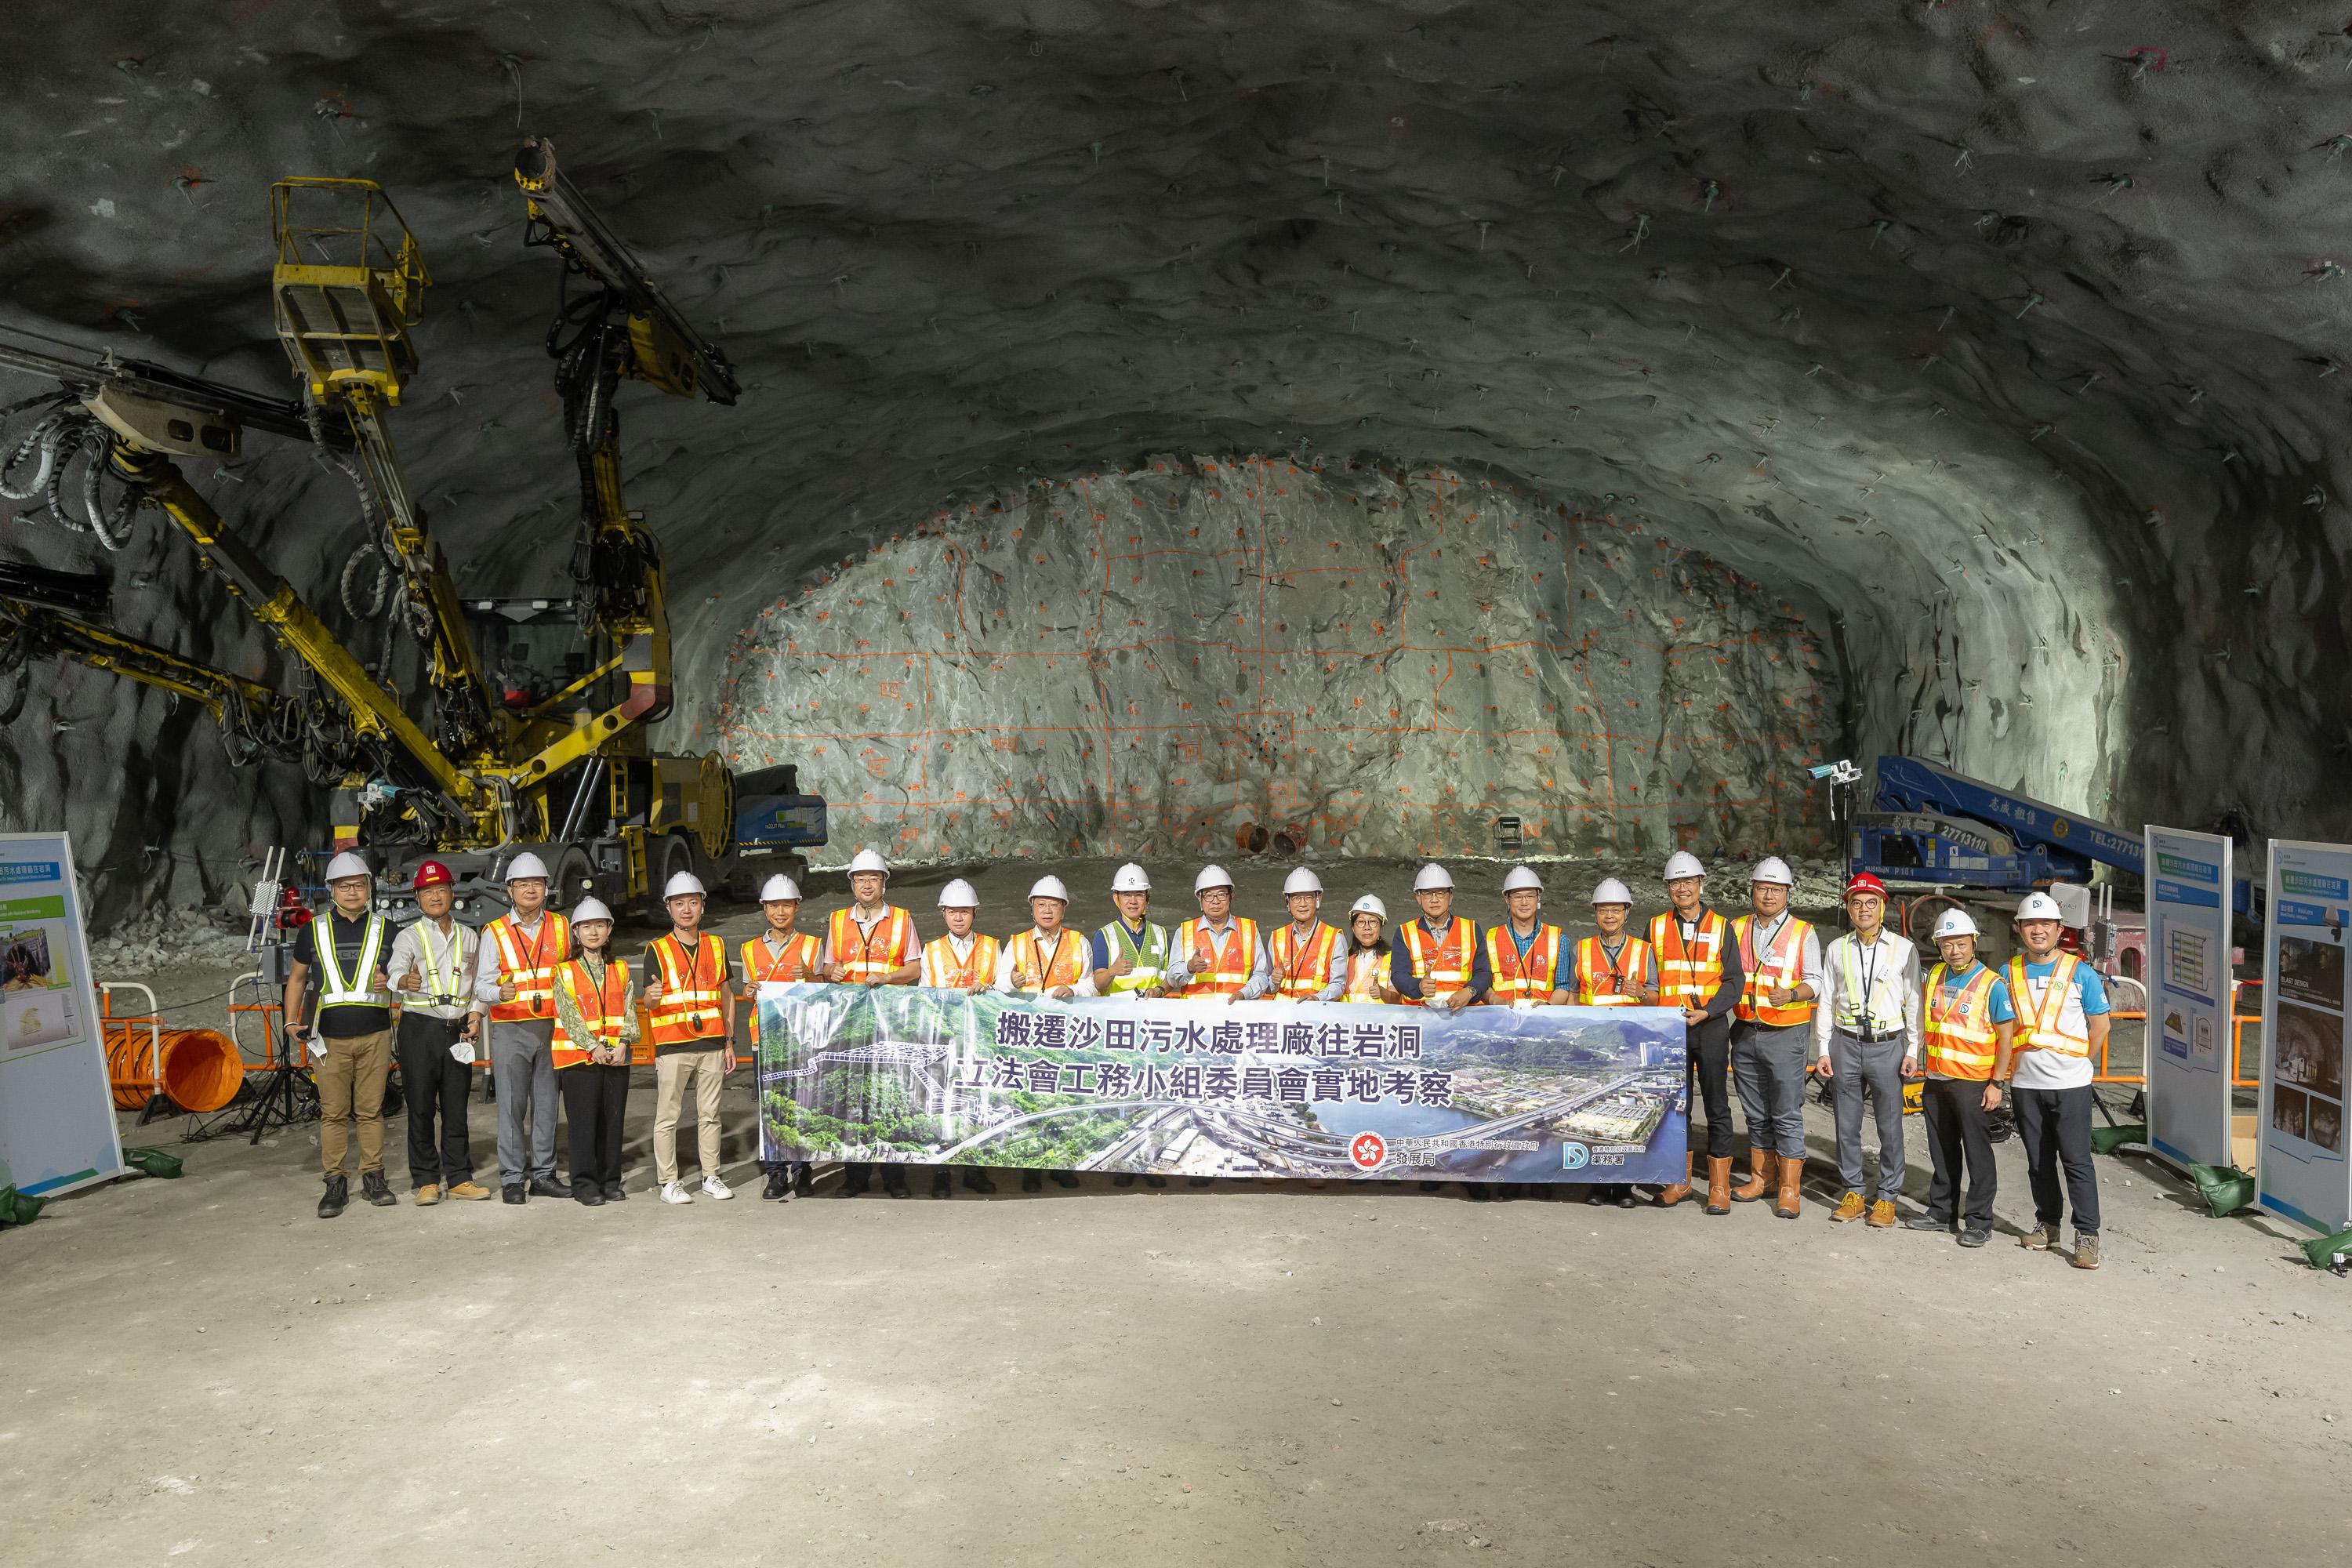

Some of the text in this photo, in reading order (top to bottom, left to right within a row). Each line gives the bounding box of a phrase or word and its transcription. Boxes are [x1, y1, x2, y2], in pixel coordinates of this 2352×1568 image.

[1941, 826, 1987, 852] 27713110
[996, 1011, 1422, 1059] 搬遷沙田污水處理廠往岩洞
[954, 1054, 1453, 1107] 立法會工務小組委員會實地考察
[1396, 1138, 1540, 1151] 中華人民共和國香港特別行政區政府
[1396, 1152, 1436, 1166] 發展局
[1592, 1154, 1624, 1166] 渠務署
